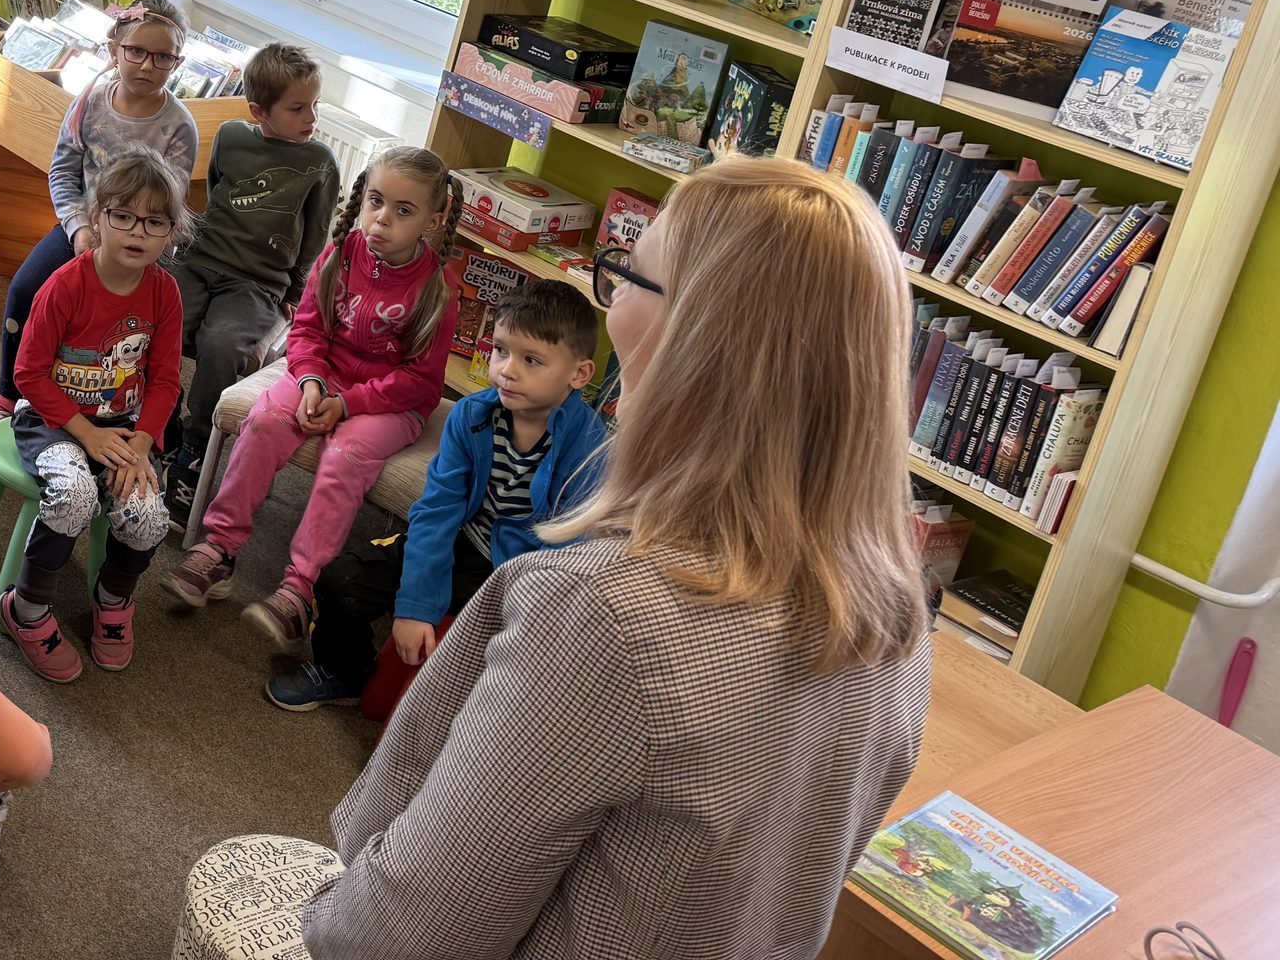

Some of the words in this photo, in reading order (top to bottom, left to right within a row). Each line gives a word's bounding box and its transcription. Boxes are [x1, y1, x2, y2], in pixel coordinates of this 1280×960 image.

[900, 7, 923, 21] zima
[1063, 26, 1094, 41] 2026
[844, 46, 888, 68] PUBLIKACE
[890, 61, 896, 70] K
[897, 63, 930, 81] PRODEJI
[475, 61, 510, 83] ČAJOVÁ
[512, 76, 554, 102] ZAHRADA
[463, 92, 500, 115] DESKOVÉ
[500, 106, 518, 125] HRY
[867, 143, 887, 183] ZKOUŠKY
[895, 204, 910, 232] DOTEK
[904, 172, 921, 204] OSUDU
[926, 177, 947, 212] ČASEM
[622, 225, 642, 240] LOTO
[924, 211, 933, 219] S
[910, 218, 931, 252] ZÁVOD
[1096, 212, 1140, 261] POMOCNICE
[1123, 230, 1155, 266] POMOCNICE
[470, 256, 517, 280] VZHŮRU
[943, 252, 956, 268] VILA
[1019, 263, 1048, 295] Poslední
[1041, 244, 1061, 264] léto
[1057, 293, 1074, 311] FREIDA
[1069, 271, 1091, 295] McFADDEN
[1076, 300, 1093, 317] FREIDA
[1088, 278, 1111, 303] McFADDEN
[934, 351, 952, 386] DÍVKA
[958, 362, 969, 378] bohů
[948, 377, 964, 407] soumraku
[994, 396, 1008, 419] PRAPOR
[921, 399, 936, 428] Lucinda
[946, 406, 954, 416] Za
[972, 413, 985, 433] T-FORCE
[979, 392, 991, 409] VELKÝ
[999, 406, 1025, 456] ZTRACENÉ
[1014, 383, 1032, 408] DĚTI
[1043, 411, 1065, 460] CHALUPA
[948, 817, 995, 852] UČILA
[996, 848, 1063, 896] POČÍTAT
[950, 807, 982, 831] JAK
[984, 829, 1008, 847] SE
[1009, 844, 1082, 894] VEVERKA
